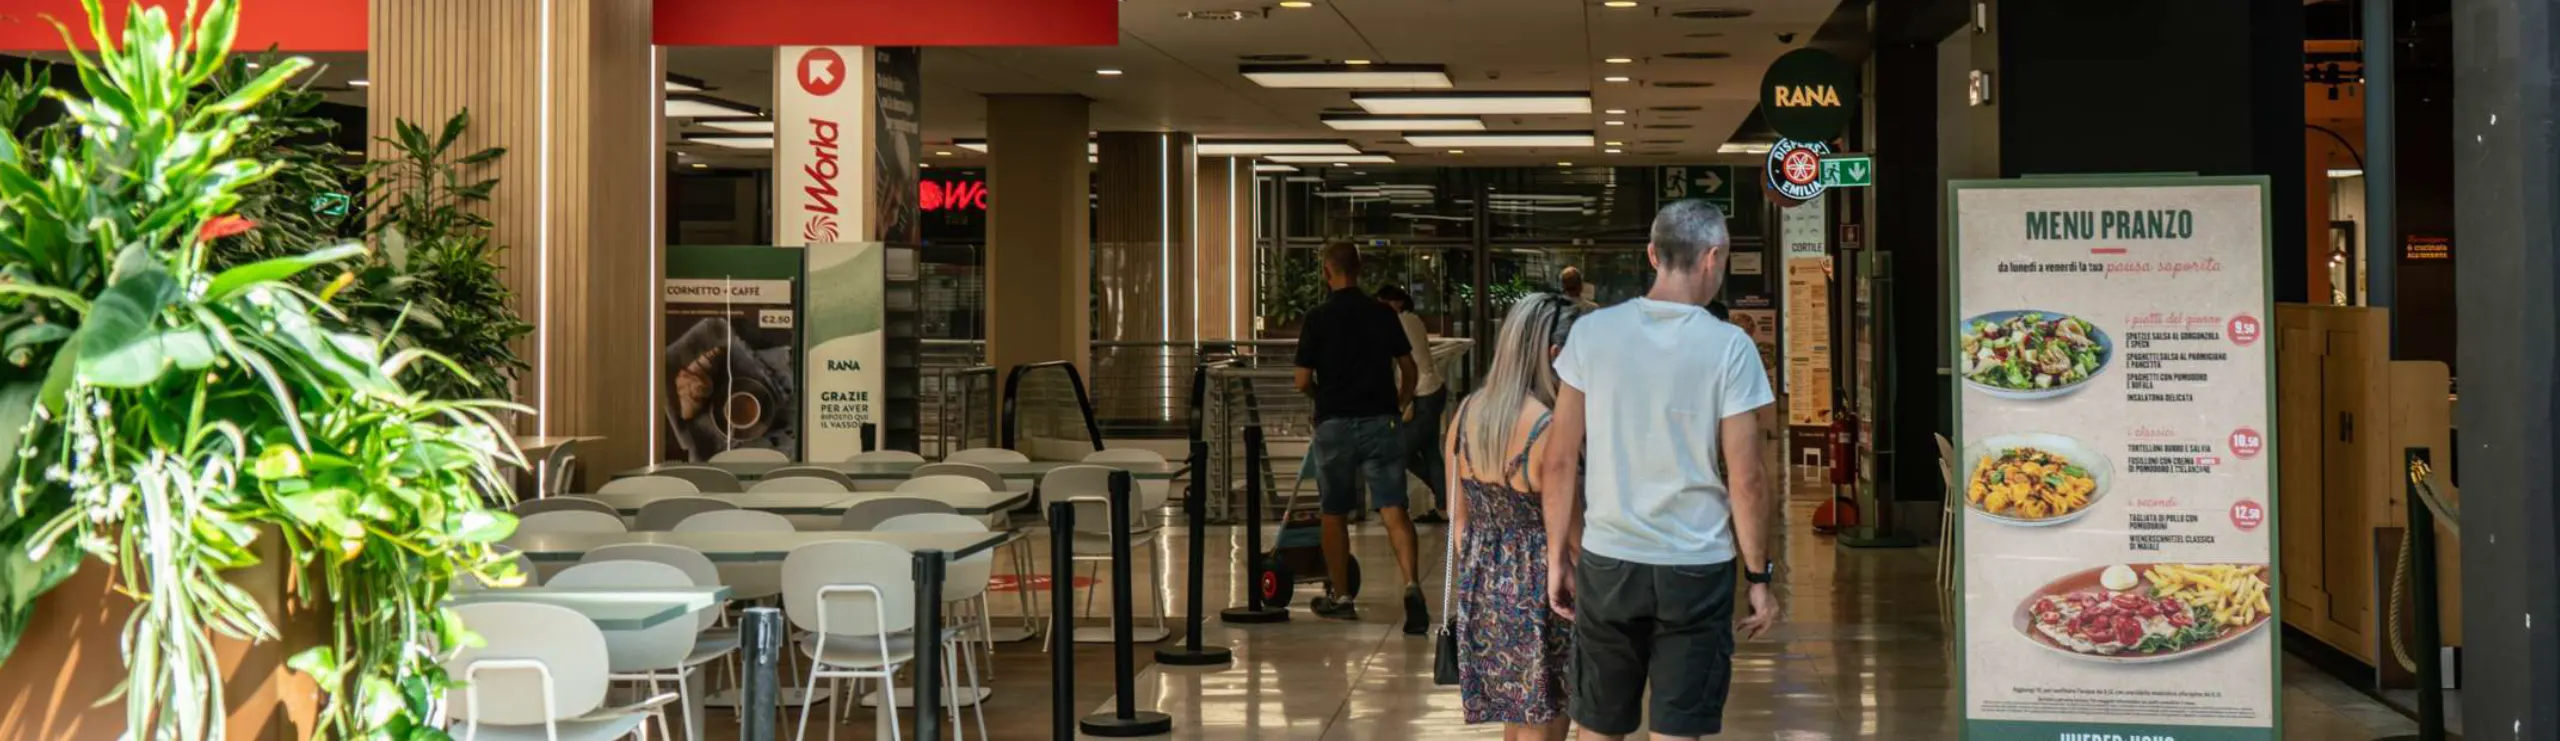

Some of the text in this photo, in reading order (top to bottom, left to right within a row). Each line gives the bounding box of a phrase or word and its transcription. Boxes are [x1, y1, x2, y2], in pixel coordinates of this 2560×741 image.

[1775, 85, 1841, 107] RANA
[804, 118, 839, 214] World
[1782, 180, 1821, 196] EMILIA
[2026, 209, 2193, 240] MENU PRANZO
[1792, 242, 1823, 253] CORTILE
[1998, 262, 2008, 273] da
[2079, 261, 2087, 273] la
[2089, 262, 2104, 273] tua
[667, 286, 720, 296] CORNETTO
[828, 360, 860, 370] RANA
[821, 391, 868, 401] GRAZIE
[821, 404, 868, 412] PER AVER
